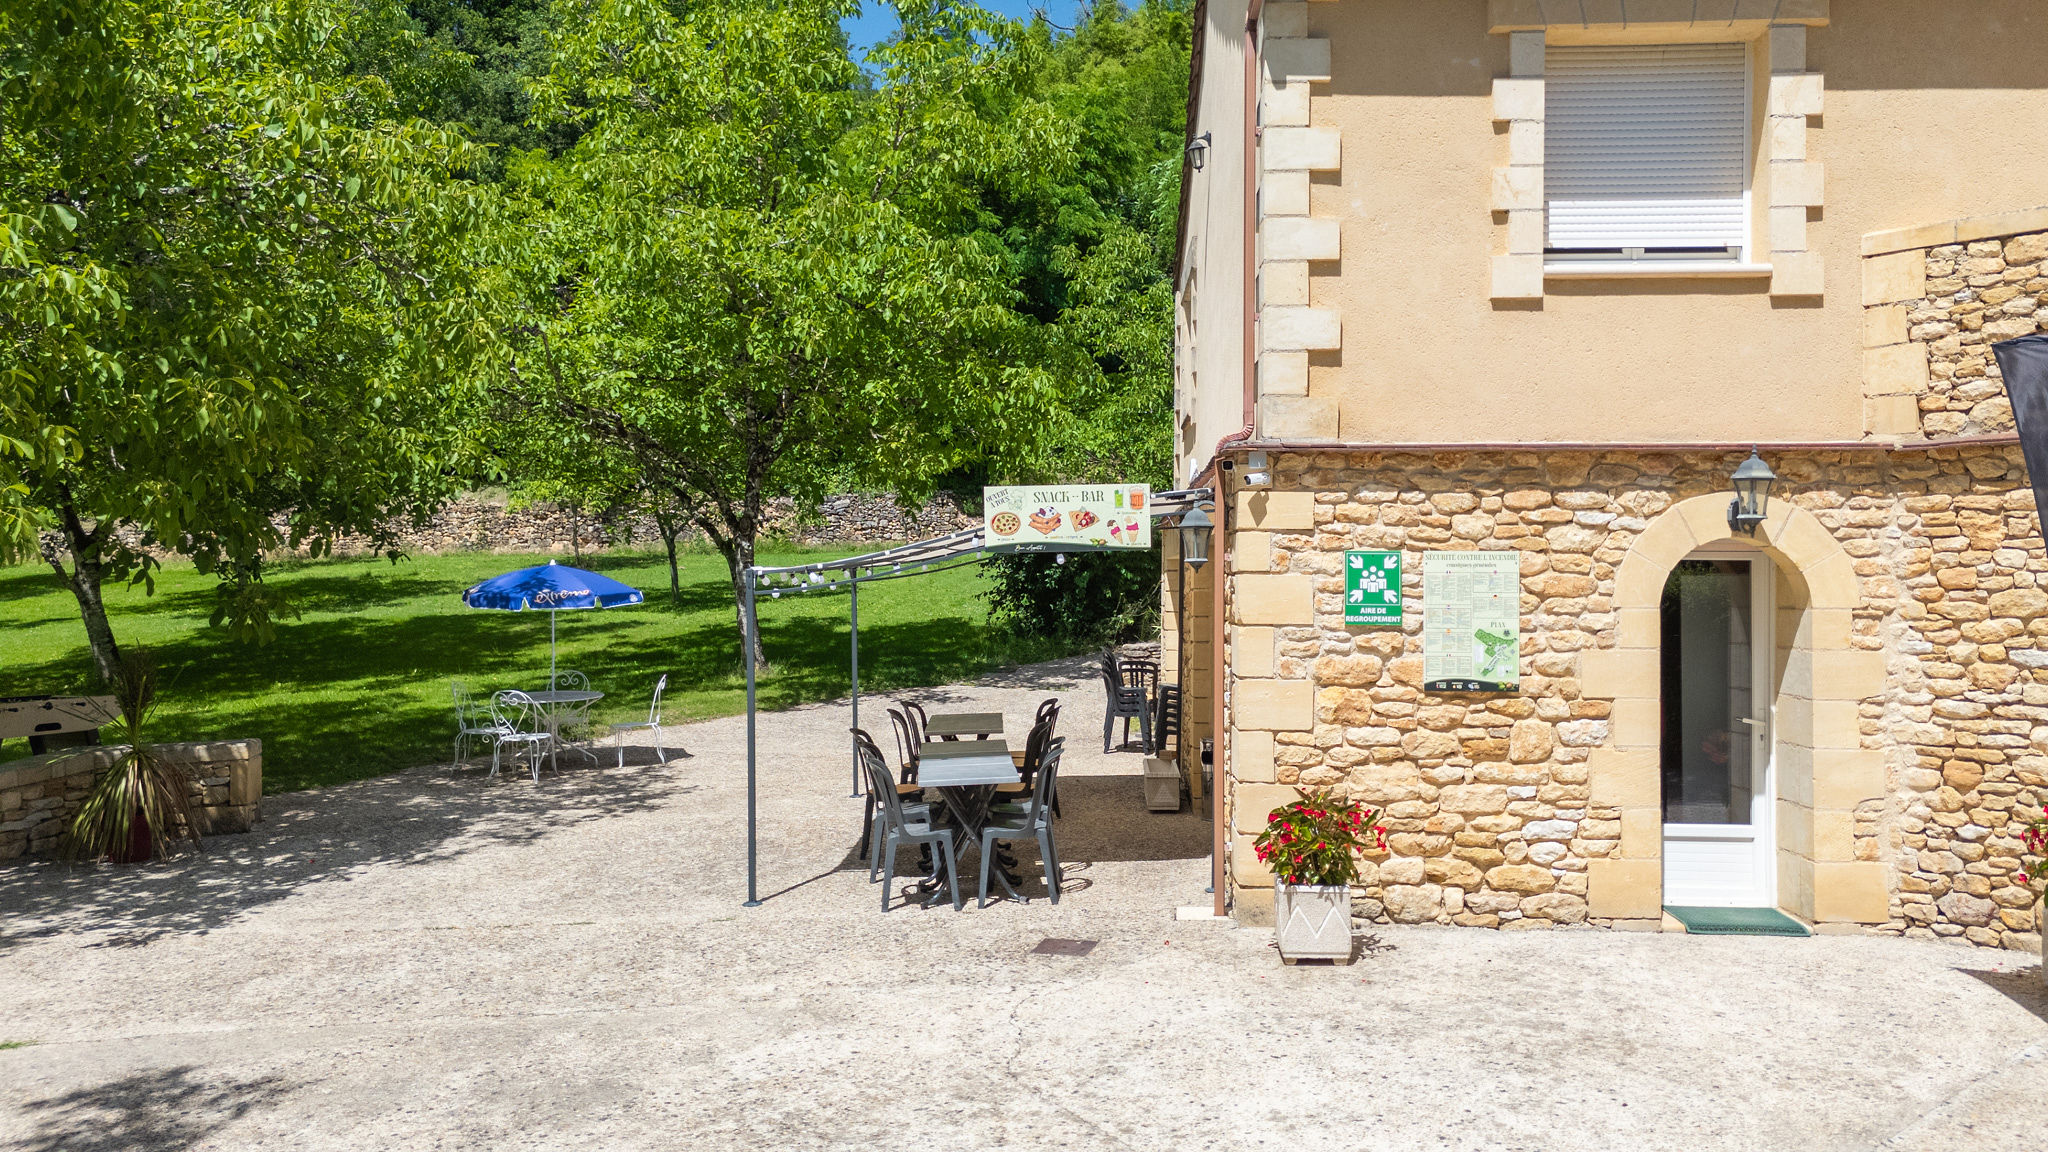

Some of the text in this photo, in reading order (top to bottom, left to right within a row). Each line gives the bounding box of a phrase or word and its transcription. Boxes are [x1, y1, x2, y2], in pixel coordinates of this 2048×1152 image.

[1033, 490, 1070, 504] SNACK
[1081, 490, 1105, 503] BAR
[1345, 615, 1401, 623] REGROUPEMENT
